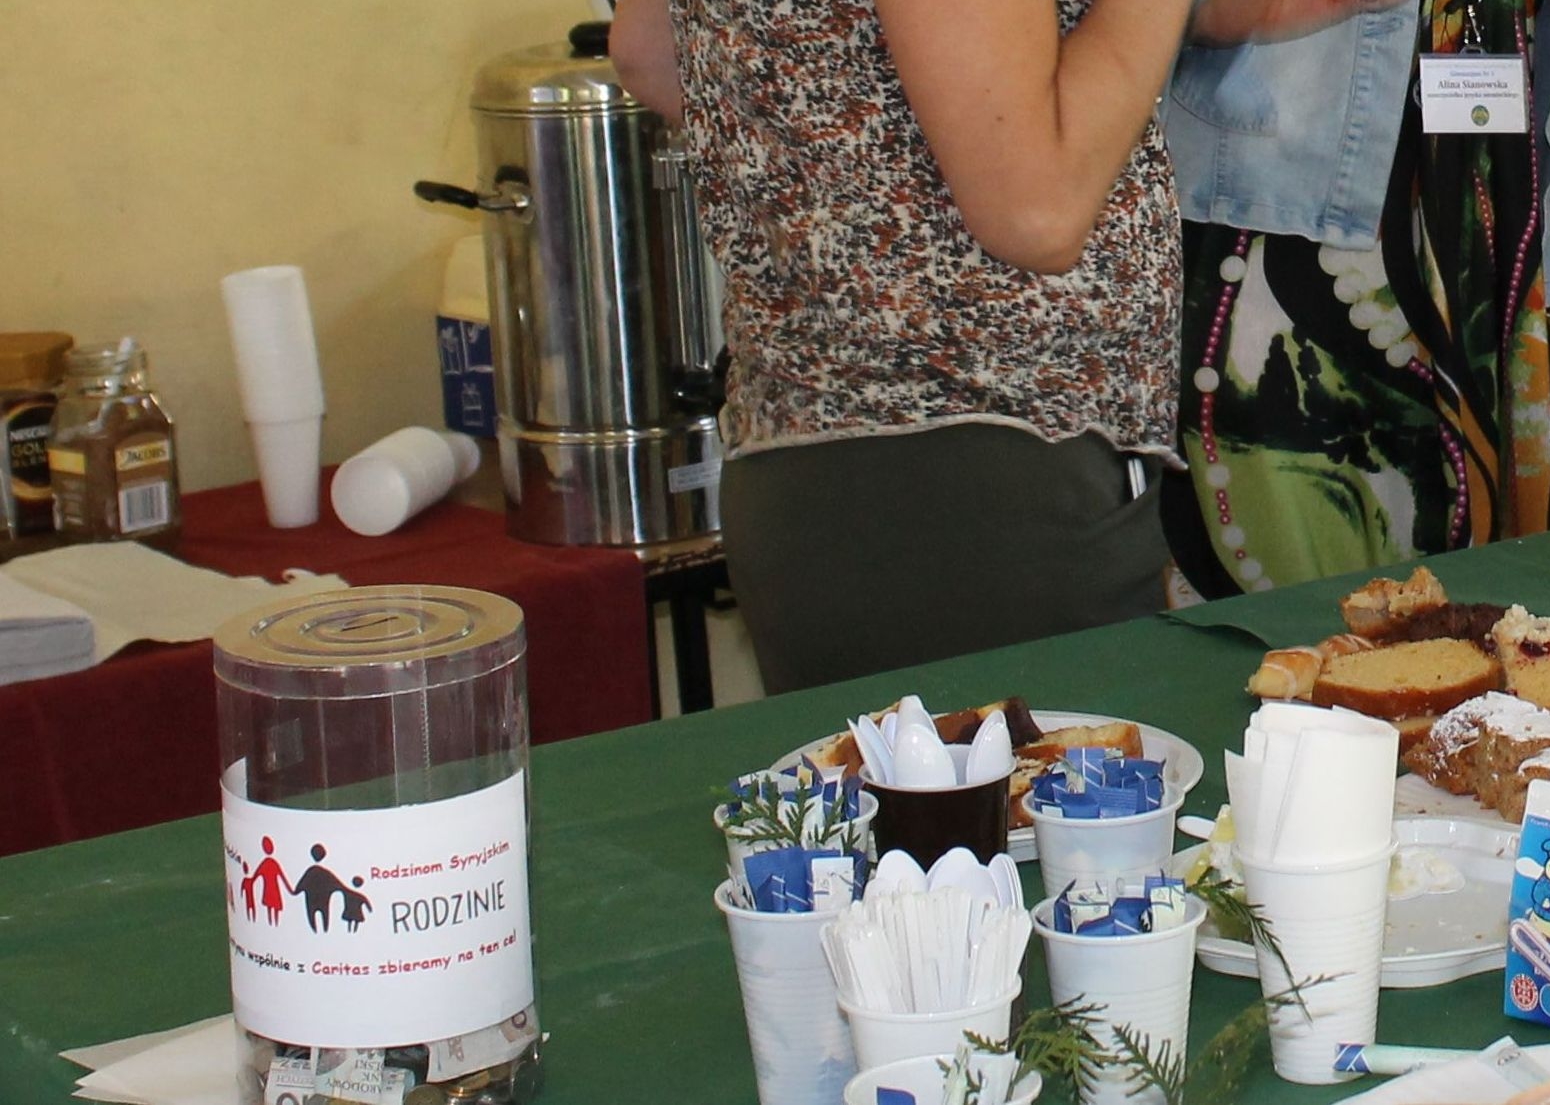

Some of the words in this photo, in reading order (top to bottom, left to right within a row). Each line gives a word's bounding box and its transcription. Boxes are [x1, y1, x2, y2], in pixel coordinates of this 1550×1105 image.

[371, 862, 443, 880] Rodzinom
[392, 880, 505, 934] RODZINIE
[312, 961, 370, 976] Caritas
[378, 955, 451, 974] zbieramy
[458, 950, 474, 963] na
[479, 942, 499, 957] ten
[503, 929, 517, 946] cel
